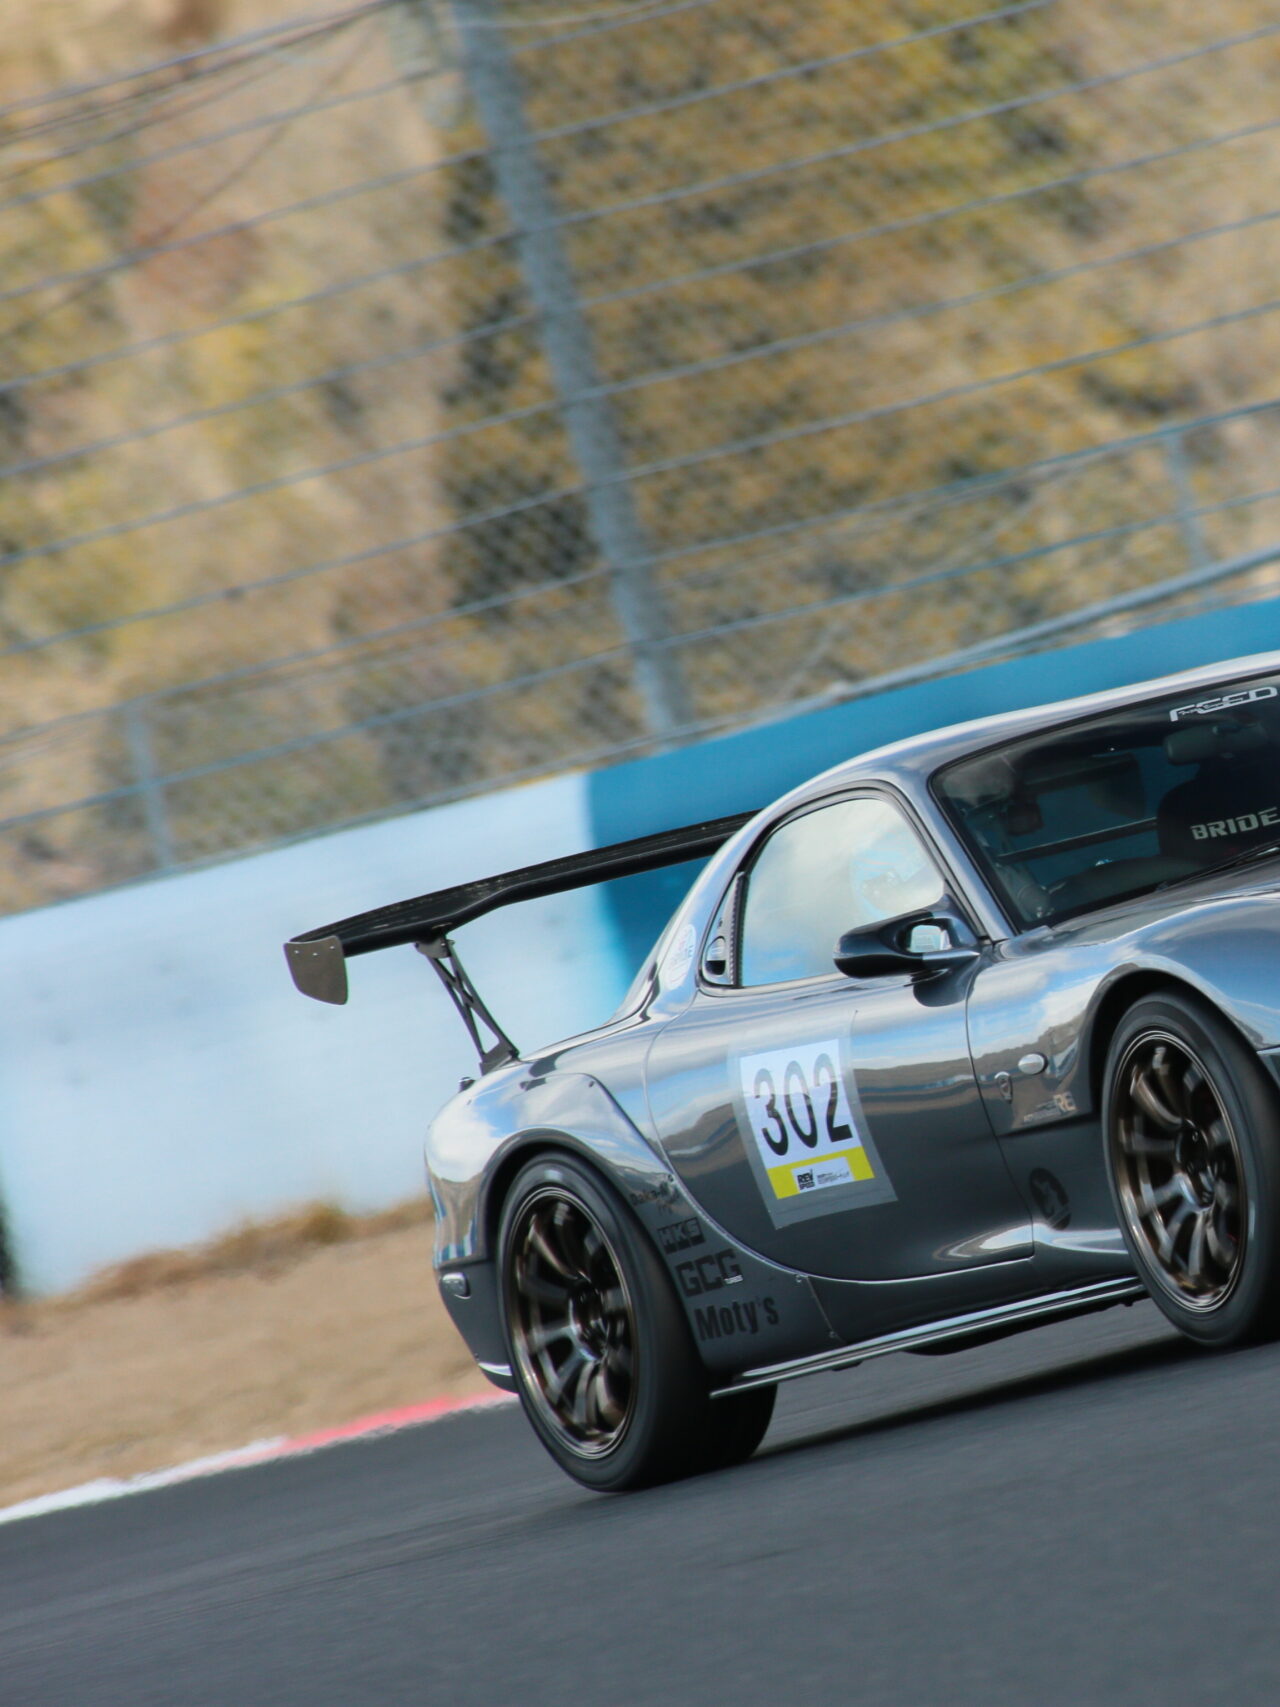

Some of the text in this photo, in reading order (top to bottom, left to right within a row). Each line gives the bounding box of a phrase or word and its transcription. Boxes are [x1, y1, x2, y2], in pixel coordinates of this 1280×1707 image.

[1169, 686, 1278, 722] FEED
[753, 1052, 853, 1157] 302
[657, 1217, 706, 1254] HKS
[675, 1249, 743, 1298] GCG
[694, 1297, 779, 1341] Moty's
